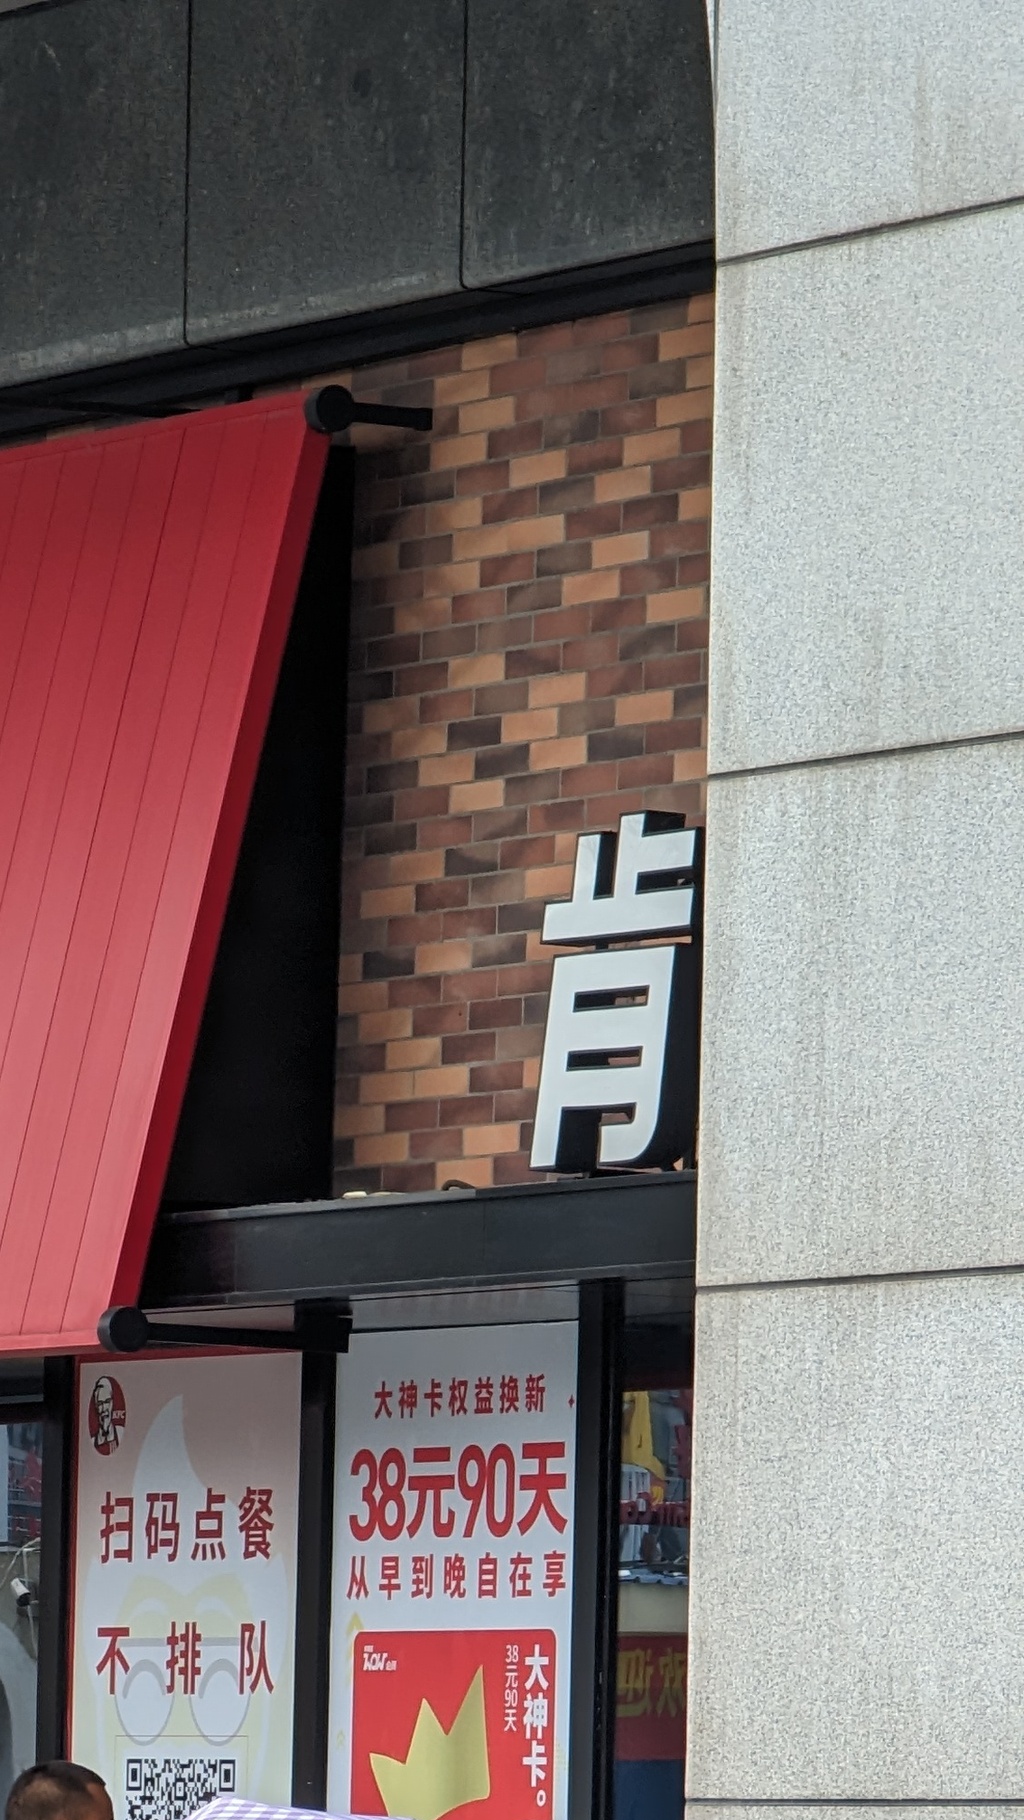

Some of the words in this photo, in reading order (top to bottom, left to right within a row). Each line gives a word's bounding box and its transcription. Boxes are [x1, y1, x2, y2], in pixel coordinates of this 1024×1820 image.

[530, 812, 697, 1168] 肯
[111, 1409, 126, 1420] KFC
[374, 1373, 547, 1419] 大神卡权益换新
[99, 1486, 275, 1564] 扫码点餐
[349, 1440, 569, 1542] 38元90天
[346, 1550, 567, 1600] 从早到晚自在享
[96, 1620, 275, 1696] 不排队
[504, 1644, 519, 1732] 38元90天
